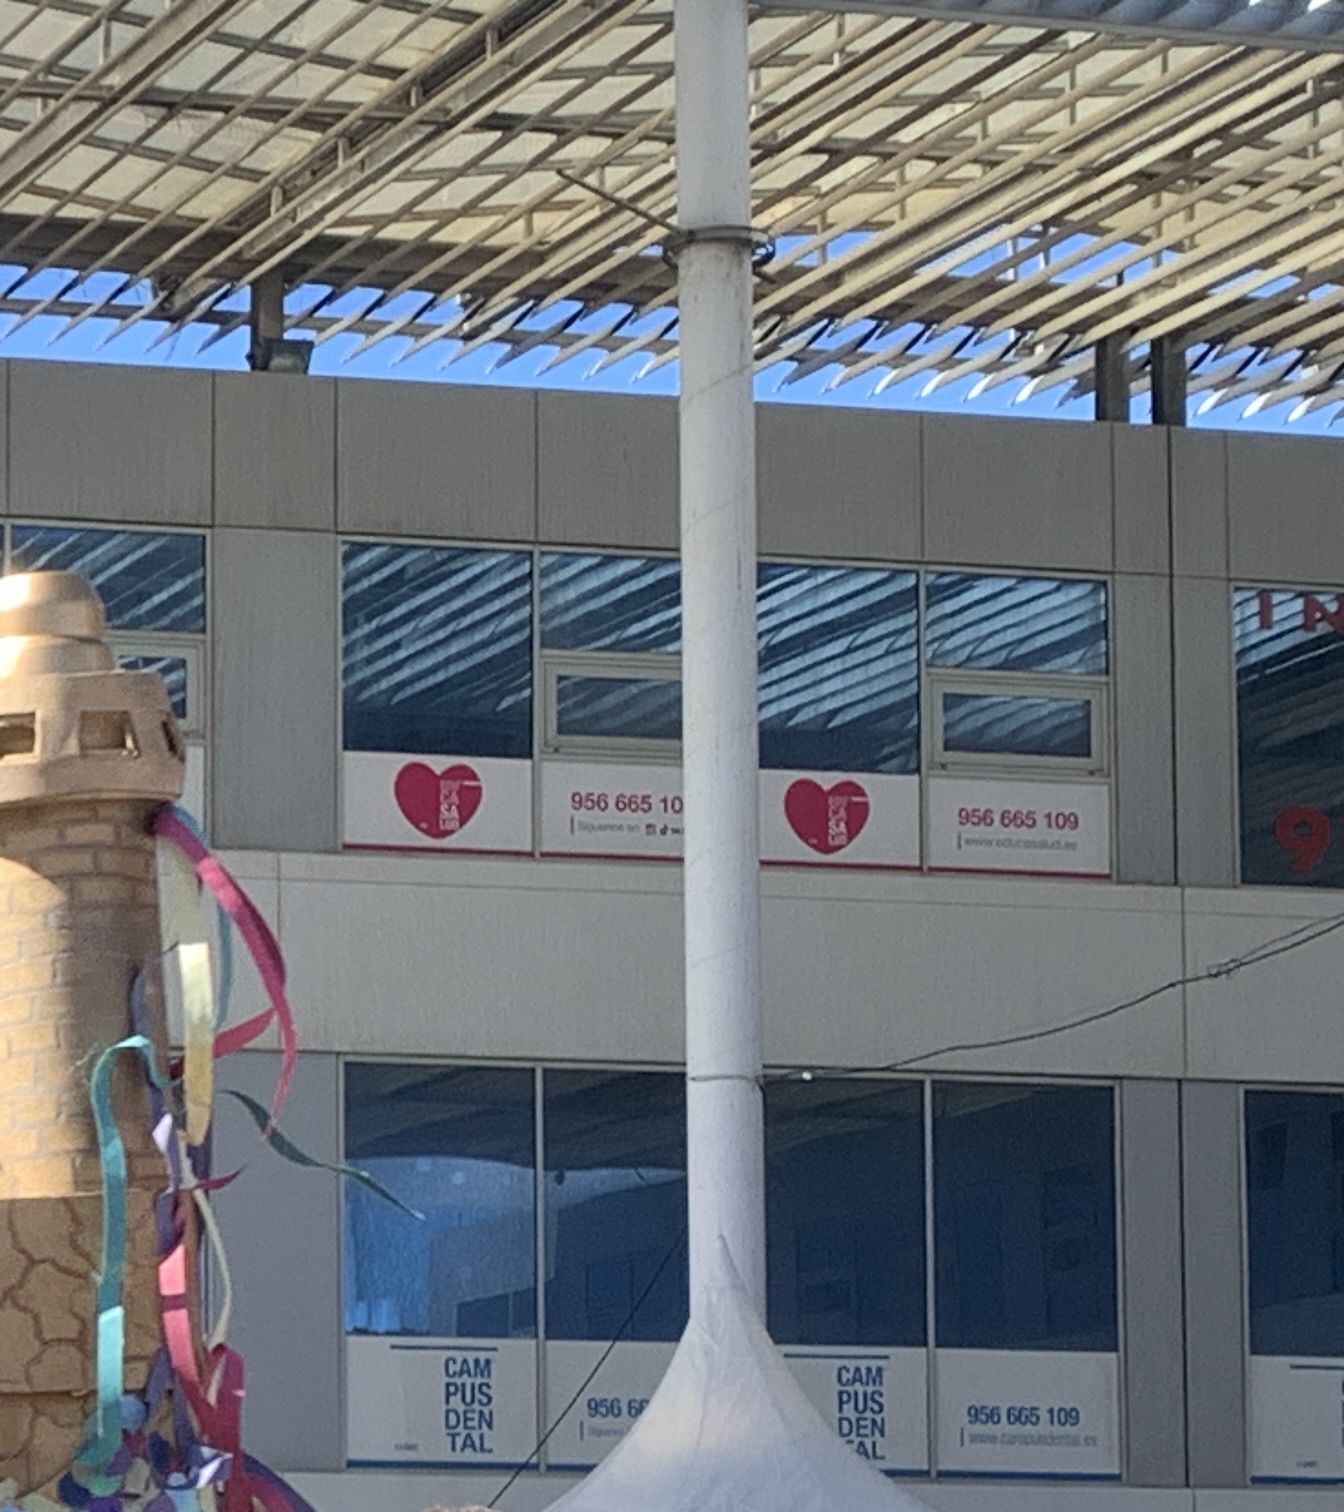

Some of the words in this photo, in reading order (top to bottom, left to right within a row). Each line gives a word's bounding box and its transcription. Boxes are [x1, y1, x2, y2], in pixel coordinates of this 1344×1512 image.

[571, 791, 609, 812] 956
[614, 793, 652, 813] 665
[659, 795, 683, 814] 10
[957, 807, 994, 827] 956
[1000, 809, 1037, 829] 665
[1044, 811, 1079, 831] 109
[444, 1356, 492, 1379] CAM
[837, 1364, 884, 1387] CAM
[444, 1381, 493, 1407] PUS
[837, 1389, 885, 1415] PUS
[587, 1396, 622, 1418] 956
[627, 1398, 650, 1418] 66
[967, 1404, 1001, 1425] 956
[1006, 1405, 1040, 1426] 665
[1047, 1407, 1080, 1427] 109
[444, 1408, 494, 1431] DEN
[838, 1416, 886, 1438] DEN
[445, 1432, 494, 1453] TAL
